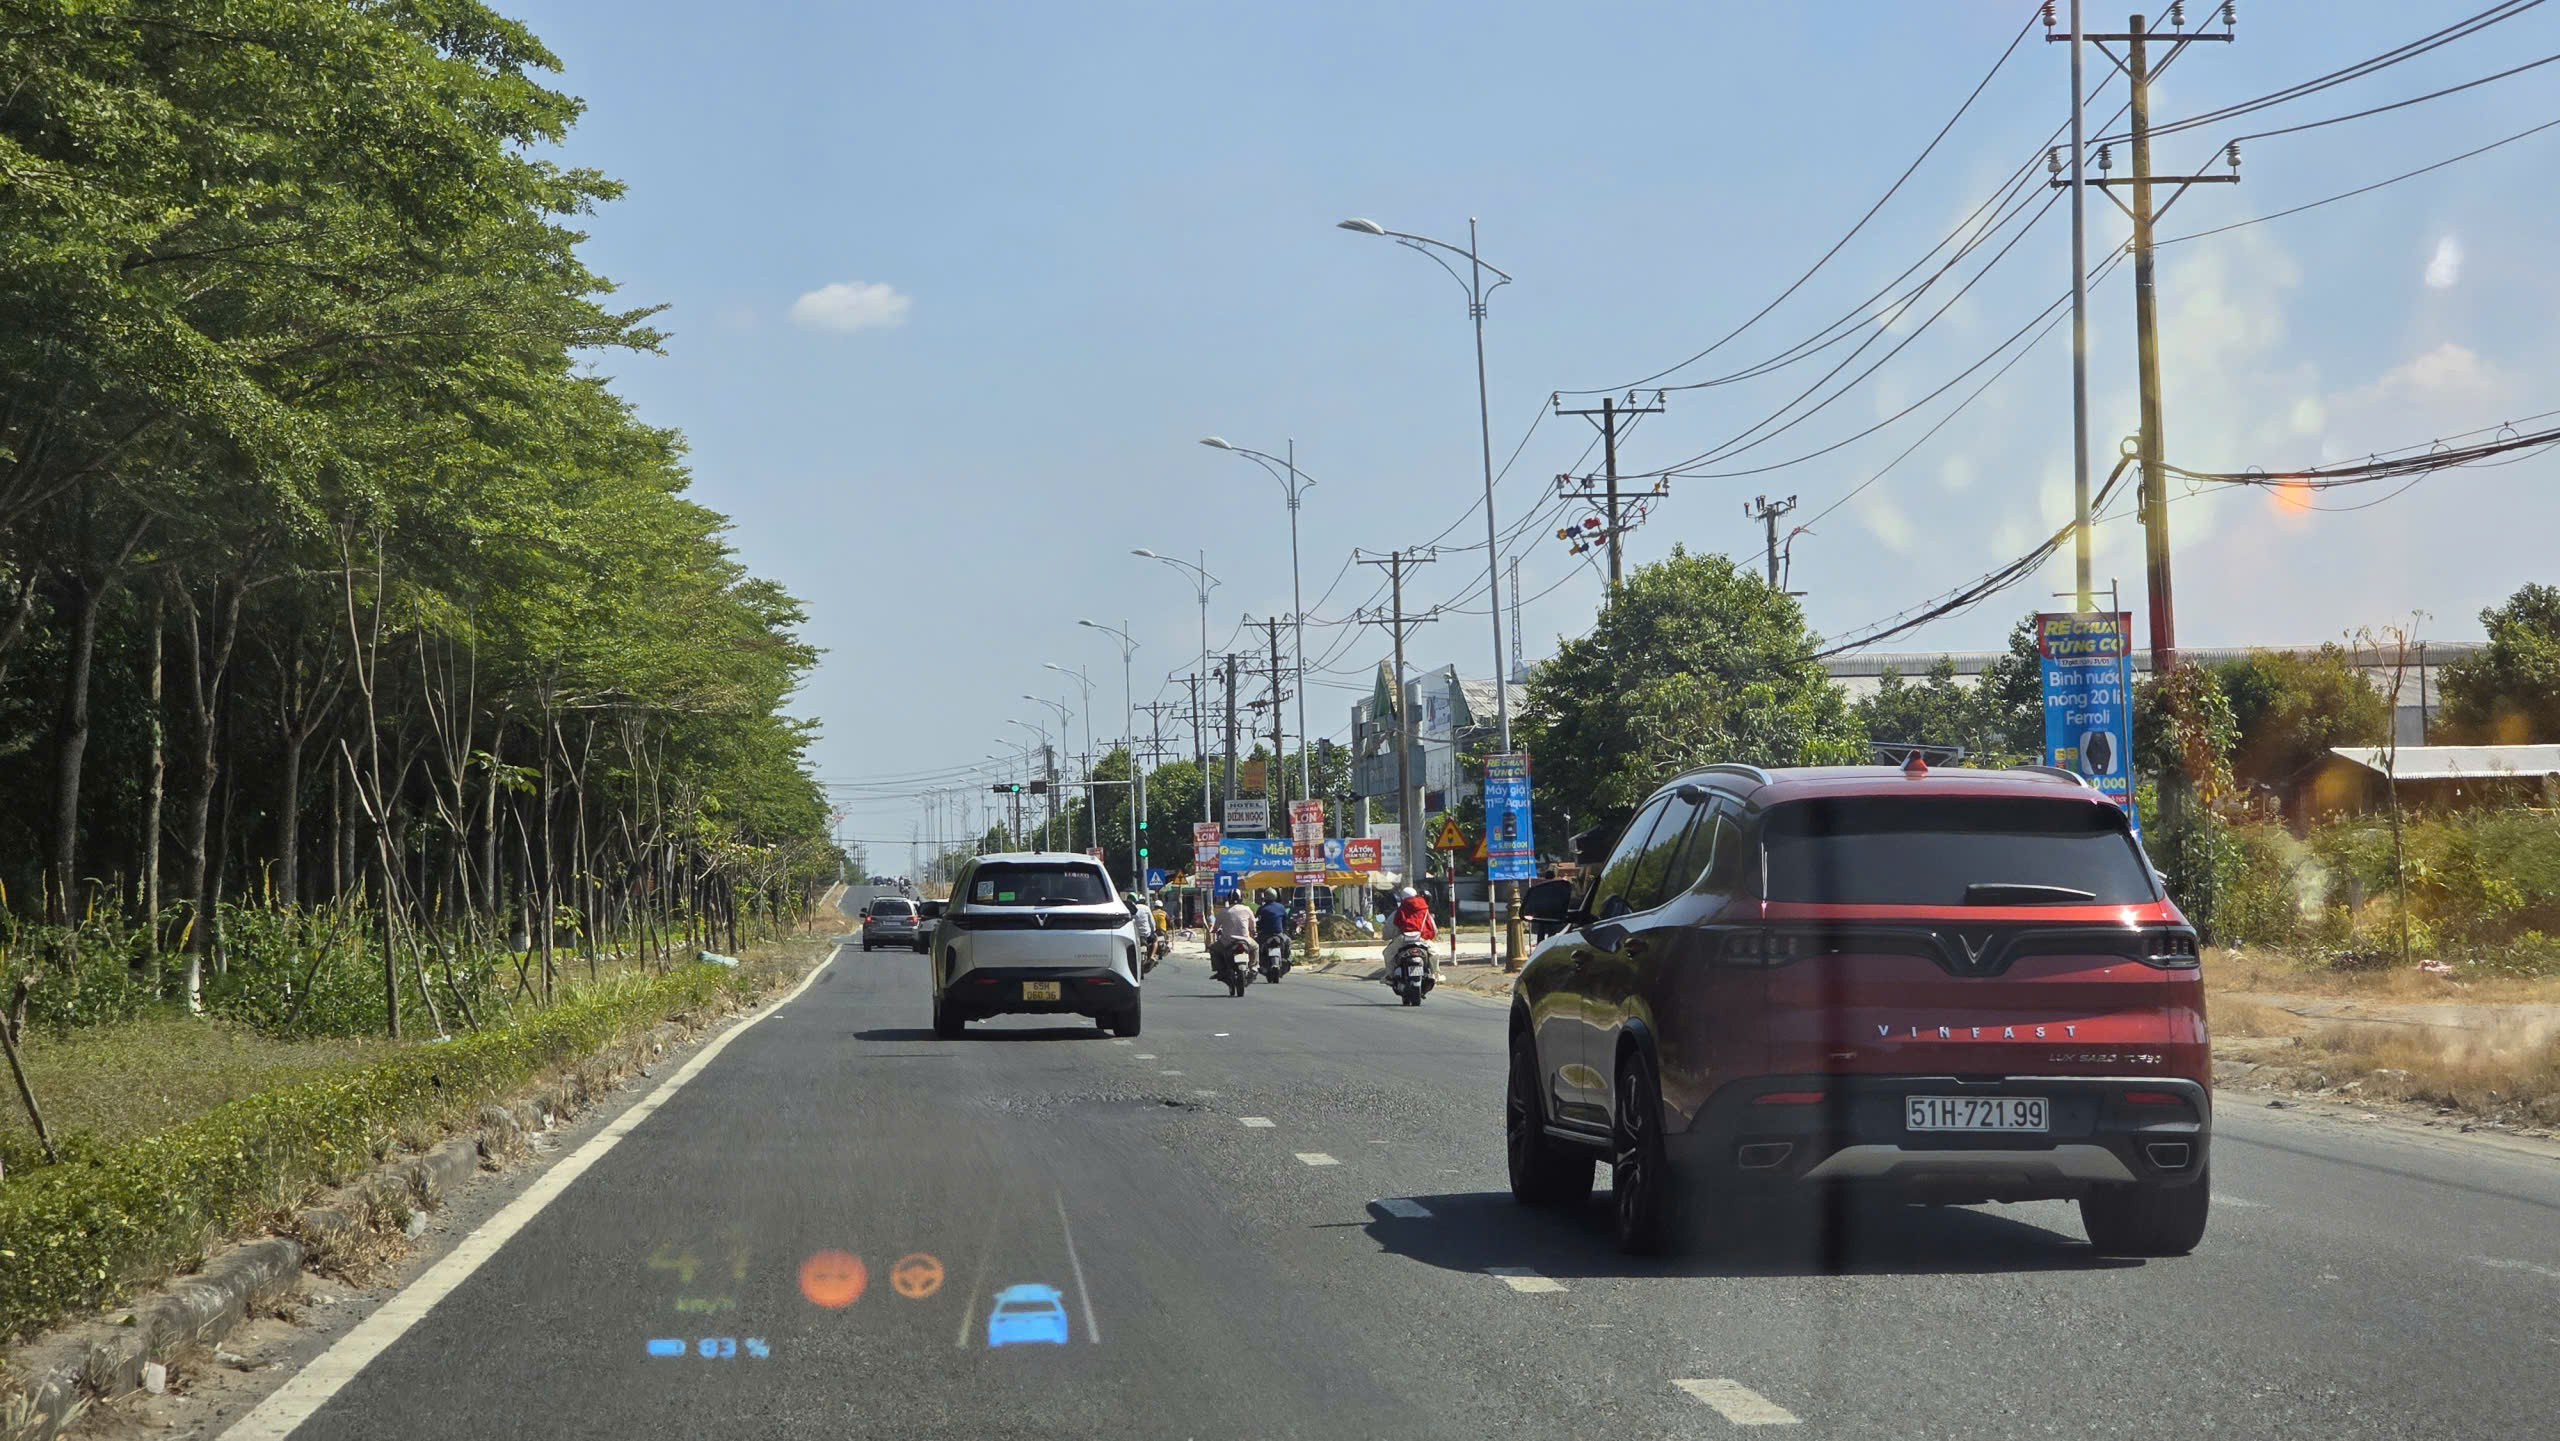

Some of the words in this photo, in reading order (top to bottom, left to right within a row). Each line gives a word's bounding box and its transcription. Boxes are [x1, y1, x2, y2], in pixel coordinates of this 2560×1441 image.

[2048, 690, 2088, 708] nóng
[2091, 689, 2109, 705] 20
[2066, 709, 2110, 725] Ferroli
[1486, 784, 1508, 797] Máy
[1253, 858, 1260, 866] 2
[1877, 1024, 2076, 1040] VINFAST
[1911, 1100, 2043, 1128] 51H-721.99
